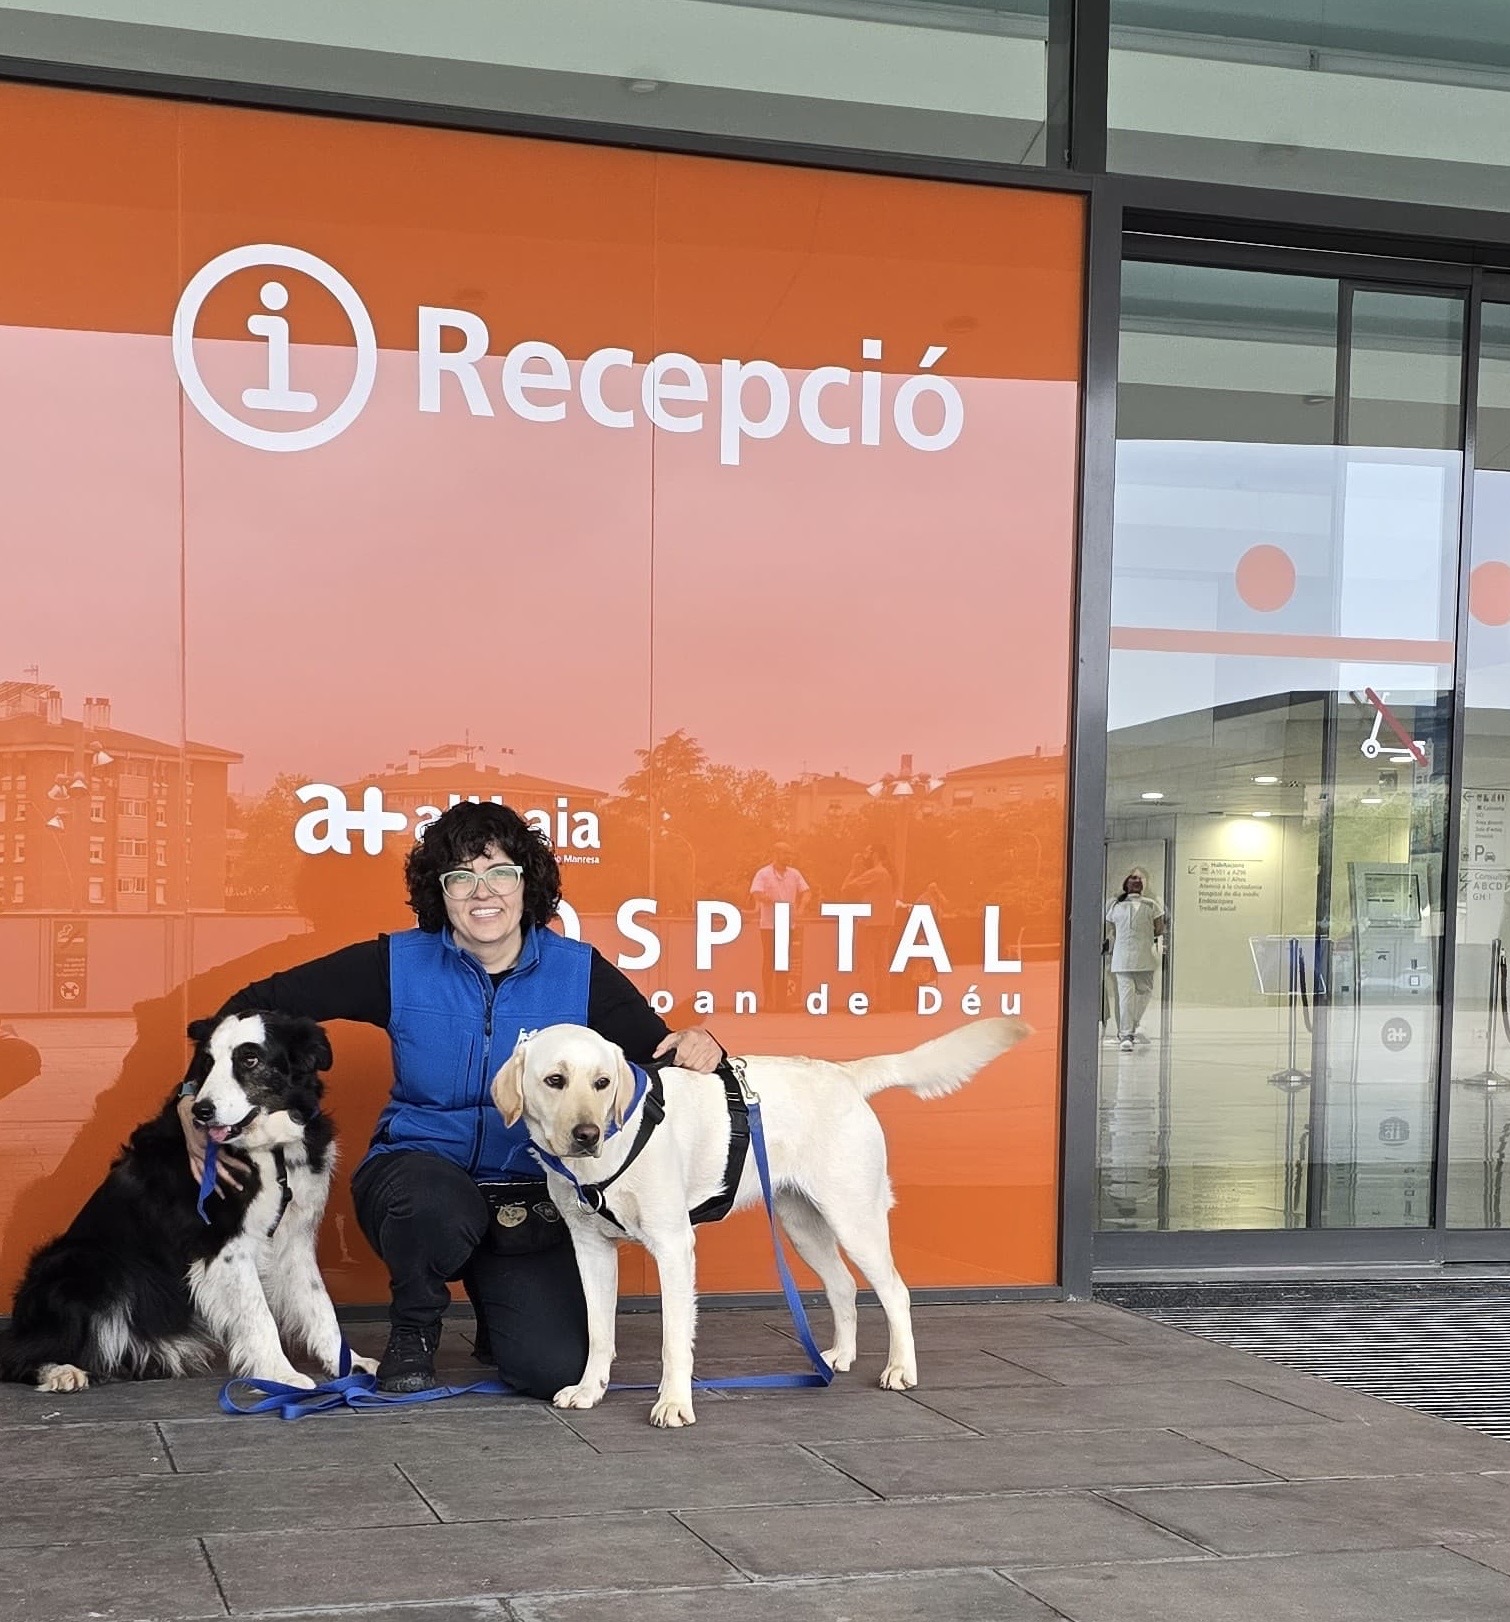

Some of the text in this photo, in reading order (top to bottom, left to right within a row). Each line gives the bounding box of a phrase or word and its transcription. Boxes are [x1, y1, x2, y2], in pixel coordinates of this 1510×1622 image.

[417, 305, 965, 466] Recepció
[414, 794, 601, 850] aaia
[563, 854, 600, 864] Manresa
[1474, 845, 1485, 861] P
[649, 982, 1022, 1016] oan de Déu
